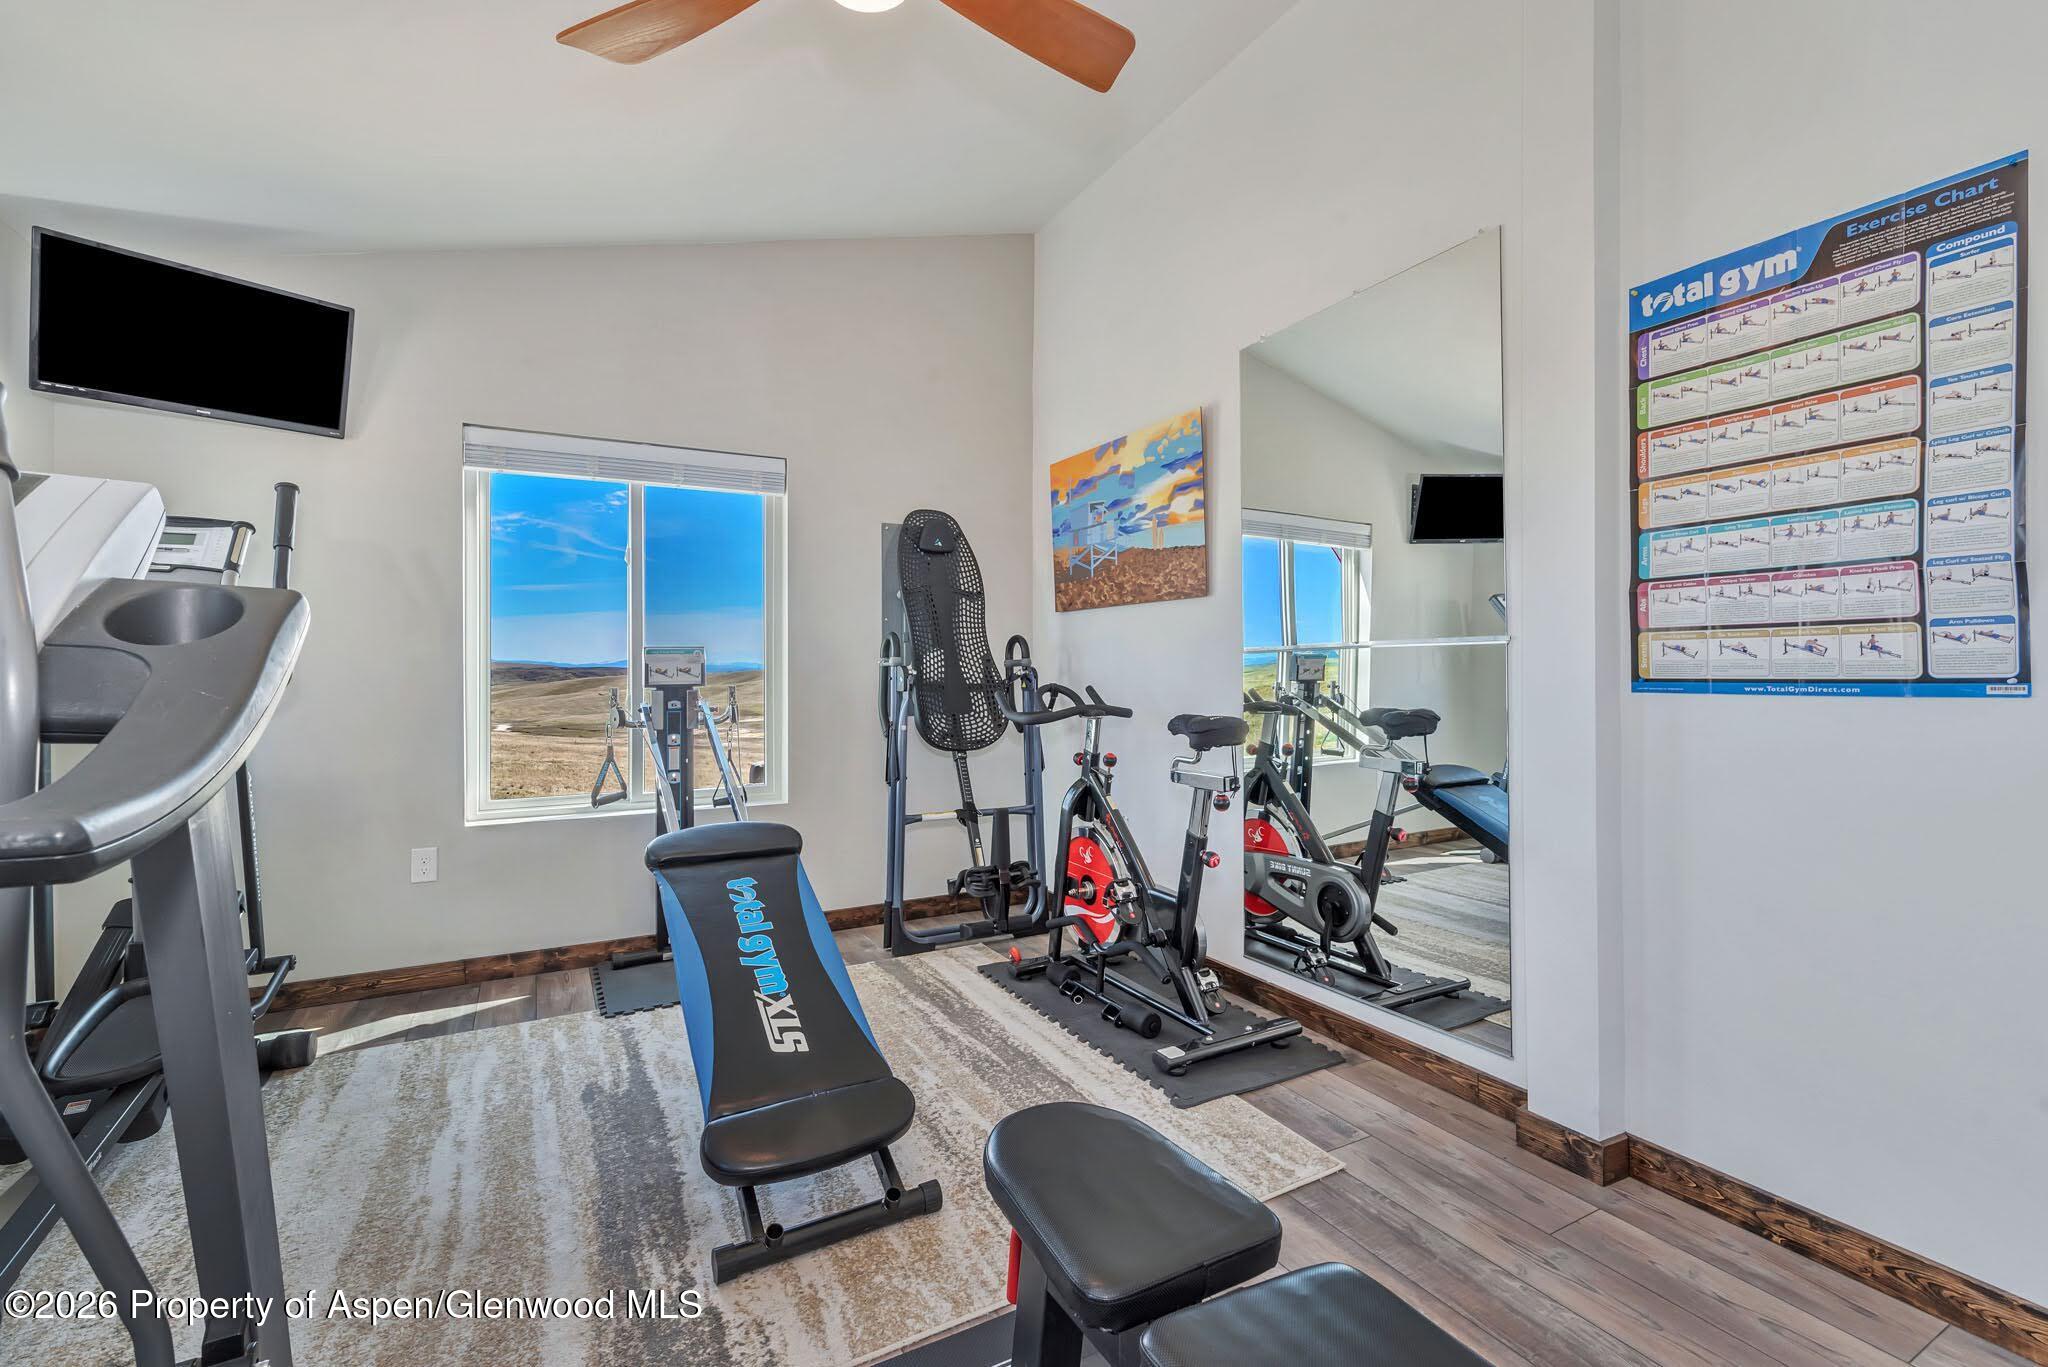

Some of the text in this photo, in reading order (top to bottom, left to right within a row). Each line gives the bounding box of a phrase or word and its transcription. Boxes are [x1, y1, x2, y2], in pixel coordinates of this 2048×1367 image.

[1846, 202, 1928, 238] Exercise
[1934, 176, 1999, 207] Chart
[1936, 225, 2006, 252] Compound
[1960, 248, 1980, 258] Surfer
[1641, 272, 1714, 317] total
[726, 876, 789, 995] total gym
[753, 990, 809, 1052] XLS
